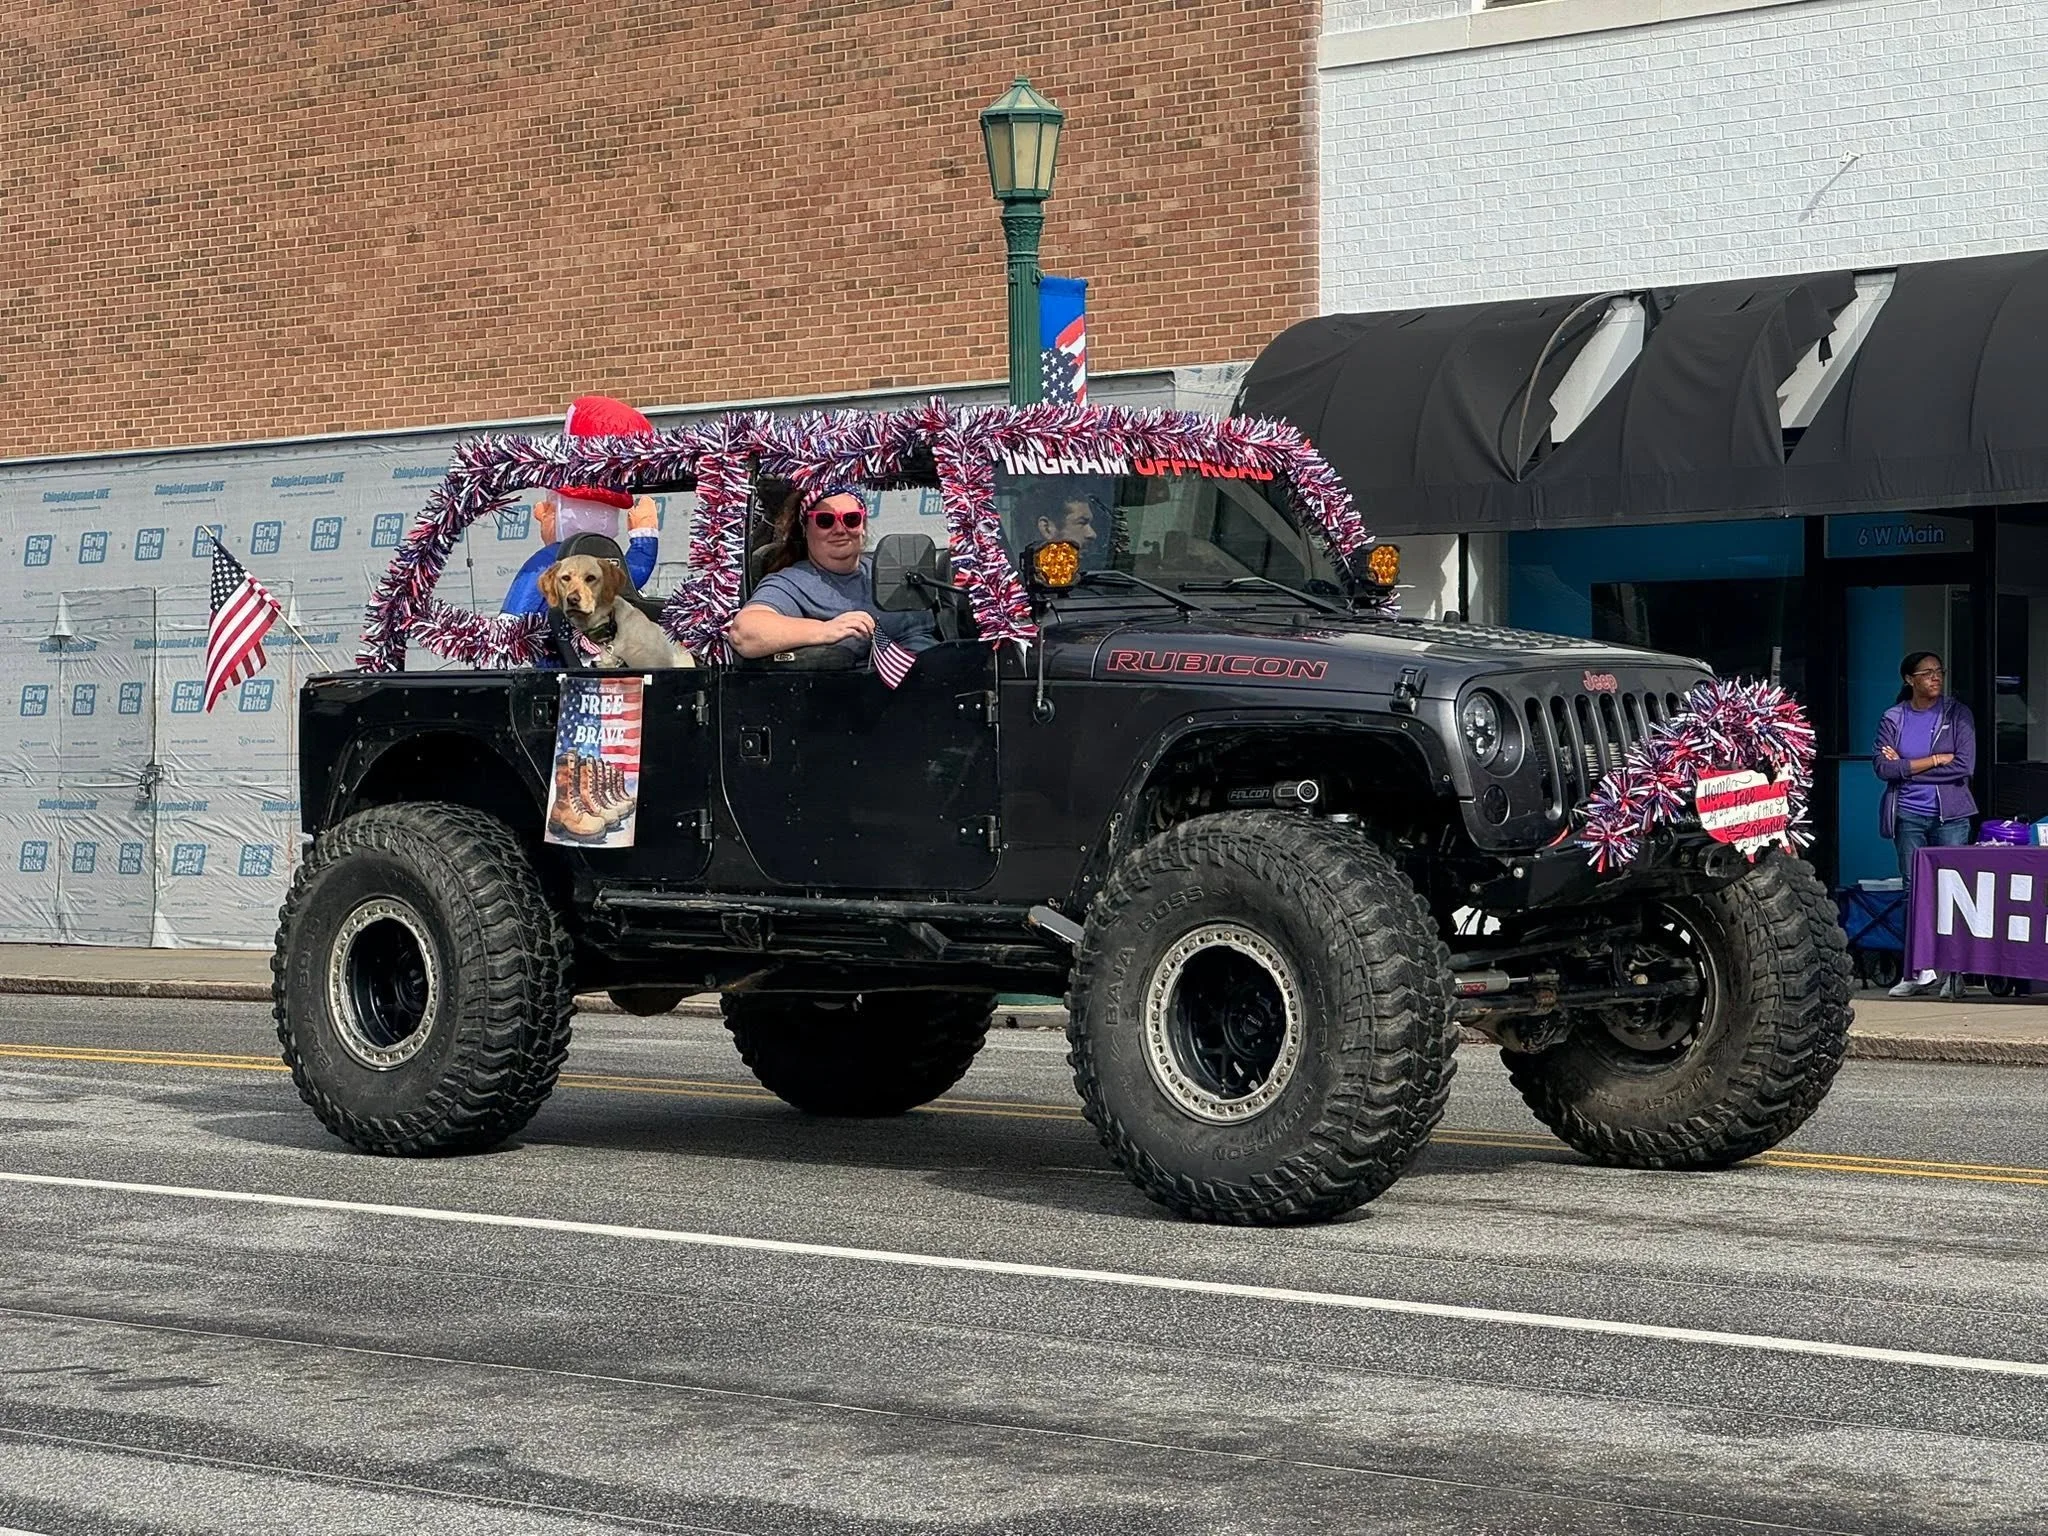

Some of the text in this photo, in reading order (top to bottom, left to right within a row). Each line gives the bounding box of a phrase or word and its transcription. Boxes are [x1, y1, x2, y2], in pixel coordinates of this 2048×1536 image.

[1004, 449, 1129, 475] INGRAM
[316, 520, 339, 535] Grip
[377, 516, 400, 532] Grip
[502, 523, 525, 538] Rite
[139, 530, 161, 546] Grip
[256, 524, 278, 539] Grip
[375, 532, 397, 545] Rite
[1858, 524, 1945, 547] 6 W Main
[28, 538, 49, 551] Grip
[83, 534, 105, 549] Grip
[254, 540, 275, 553] Rite
[314, 536, 336, 549] Rite
[27, 552, 47, 565] Rite
[81, 549, 102, 562] Rite
[138, 546, 158, 559] Rite
[1106, 650, 1329, 680] RUBICON
[1583, 671, 1617, 693] Jeep
[25, 688, 46, 701] Grip
[75, 686, 94, 700] Grip
[122, 685, 140, 699] Grip
[177, 683, 202, 698] Grip
[245, 682, 270, 697] Grip
[23, 702, 42, 714] Rite
[74, 700, 92, 713] Rite
[121, 700, 138, 713] Rite
[175, 699, 199, 711] Rite
[243, 698, 267, 710] Rite
[580, 694, 624, 715] FREE
[573, 725, 626, 746] BRAVE
[1230, 789, 1270, 800] FALCON
[24, 843, 44, 857] Grip
[1138, 885, 1205, 933] BOSS
[1106, 947, 1136, 1025] BAJA
